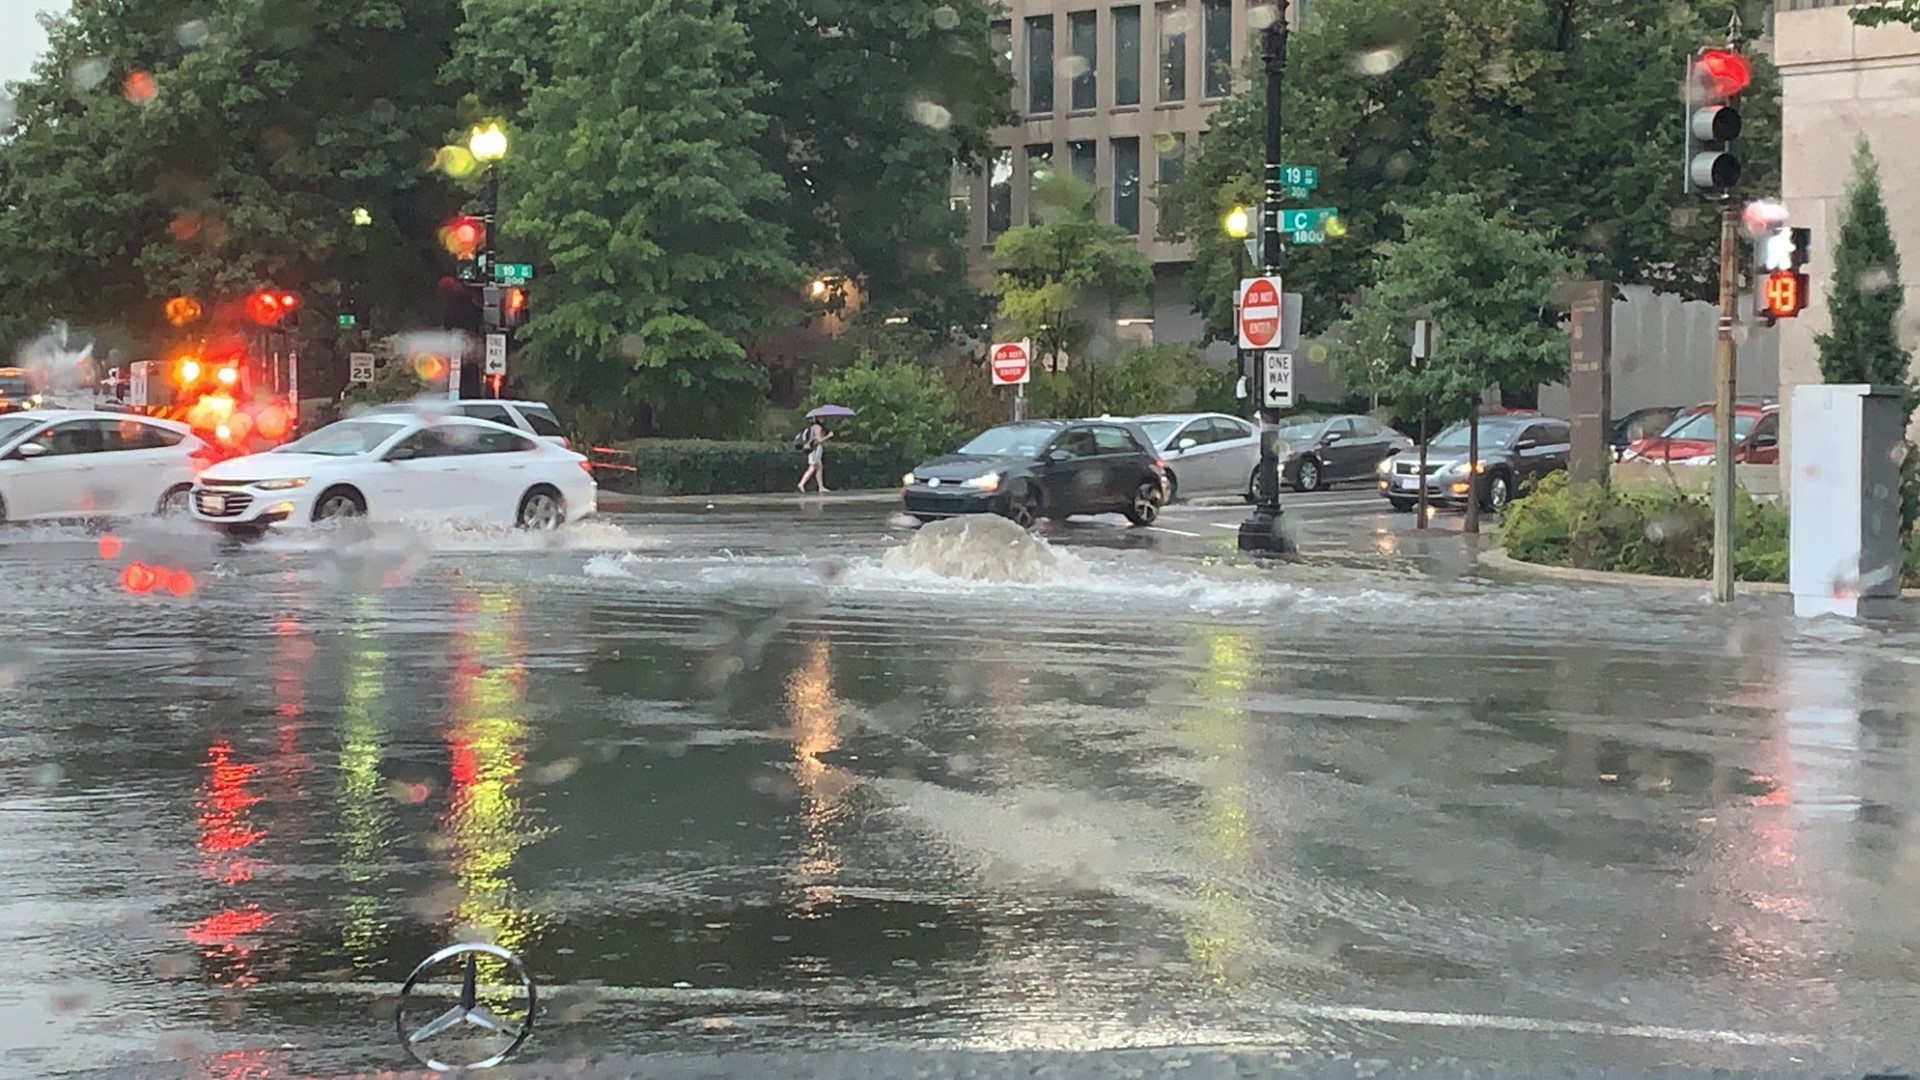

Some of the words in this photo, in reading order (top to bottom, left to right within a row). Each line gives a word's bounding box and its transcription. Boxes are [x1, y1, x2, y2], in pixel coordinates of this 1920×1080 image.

[1286, 167, 1301, 184] 19
[1294, 212, 1308, 230] C
[1294, 230, 1325, 242] 1800
[503, 264, 516, 277] 19
[1248, 292, 1259, 304] DO
[1260, 290, 1274, 303] NOT
[1767, 277, 1795, 311] 43
[1249, 321, 1272, 335] ENTE
[1268, 356, 1289, 370] ONE
[353, 367, 373, 379] 25
[1269, 372, 1290, 384] WAY
